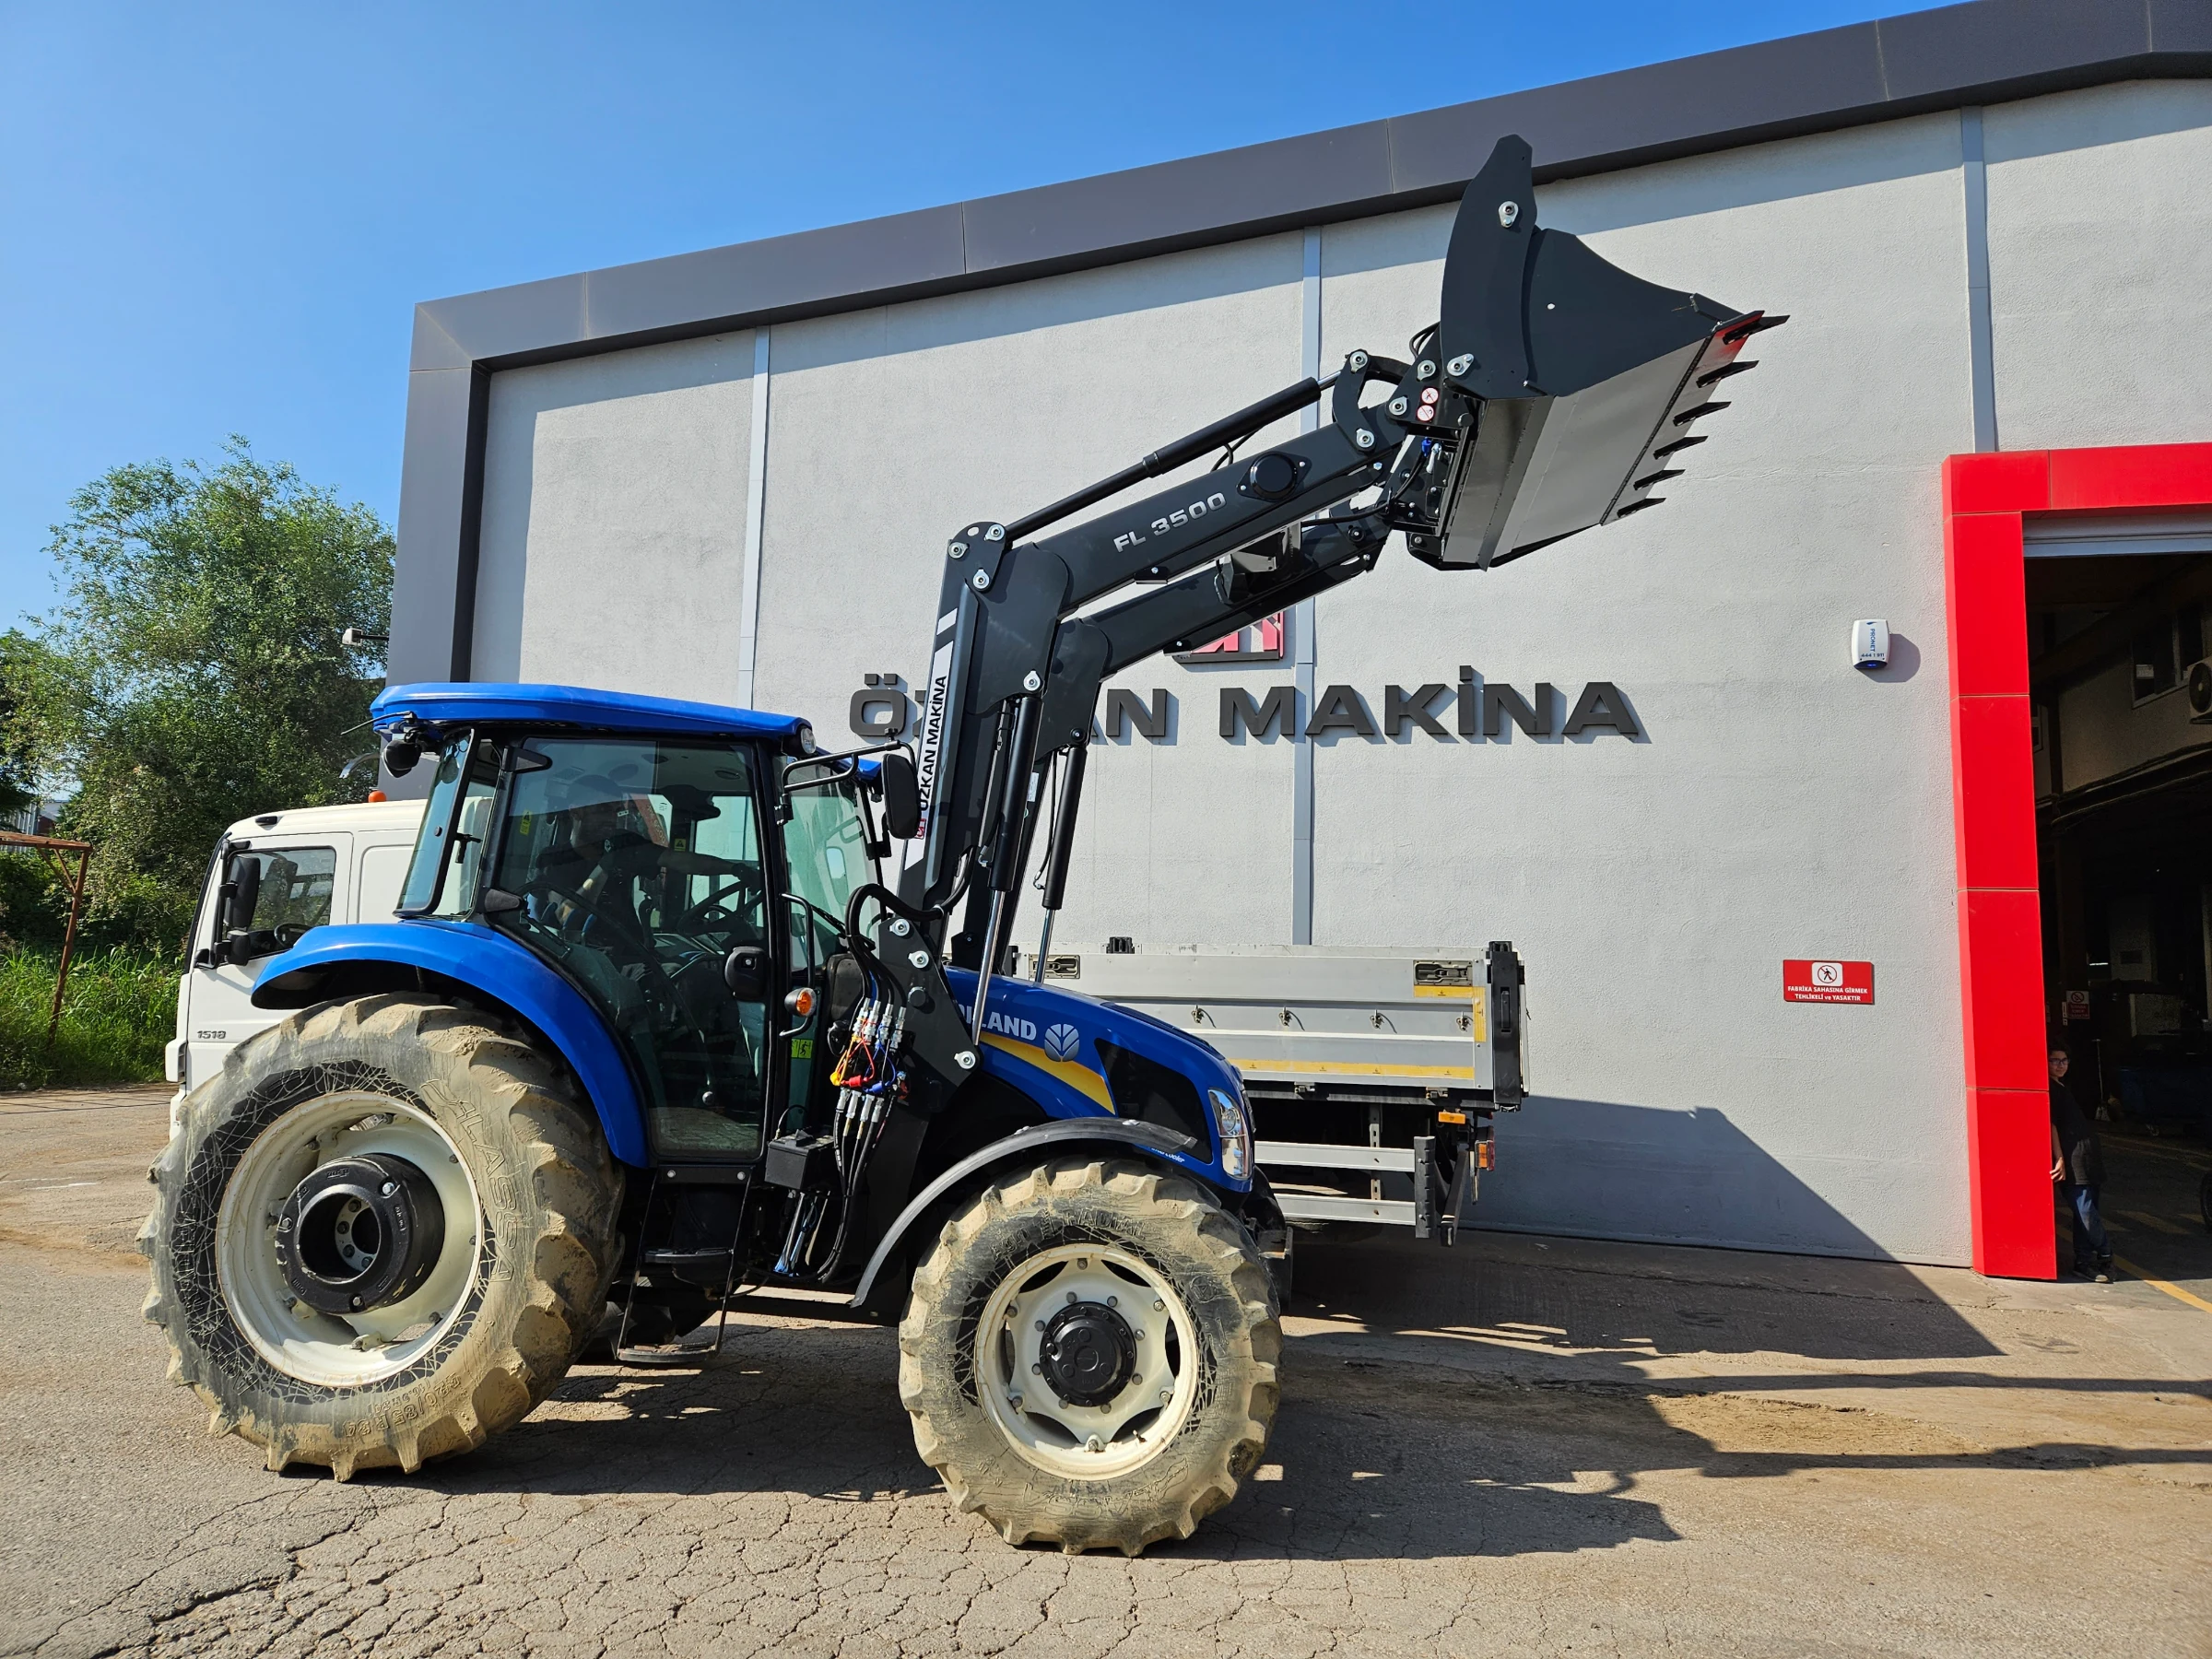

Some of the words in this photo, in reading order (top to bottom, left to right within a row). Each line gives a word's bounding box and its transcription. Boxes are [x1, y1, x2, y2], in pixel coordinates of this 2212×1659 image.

[1113, 531, 1147, 553] FL
[1151, 492, 1227, 536] 3500
[926, 676, 947, 745] MAKİNA
[1219, 665, 1639, 736] MAKİNA
[196, 1030, 227, 1040] 1518
